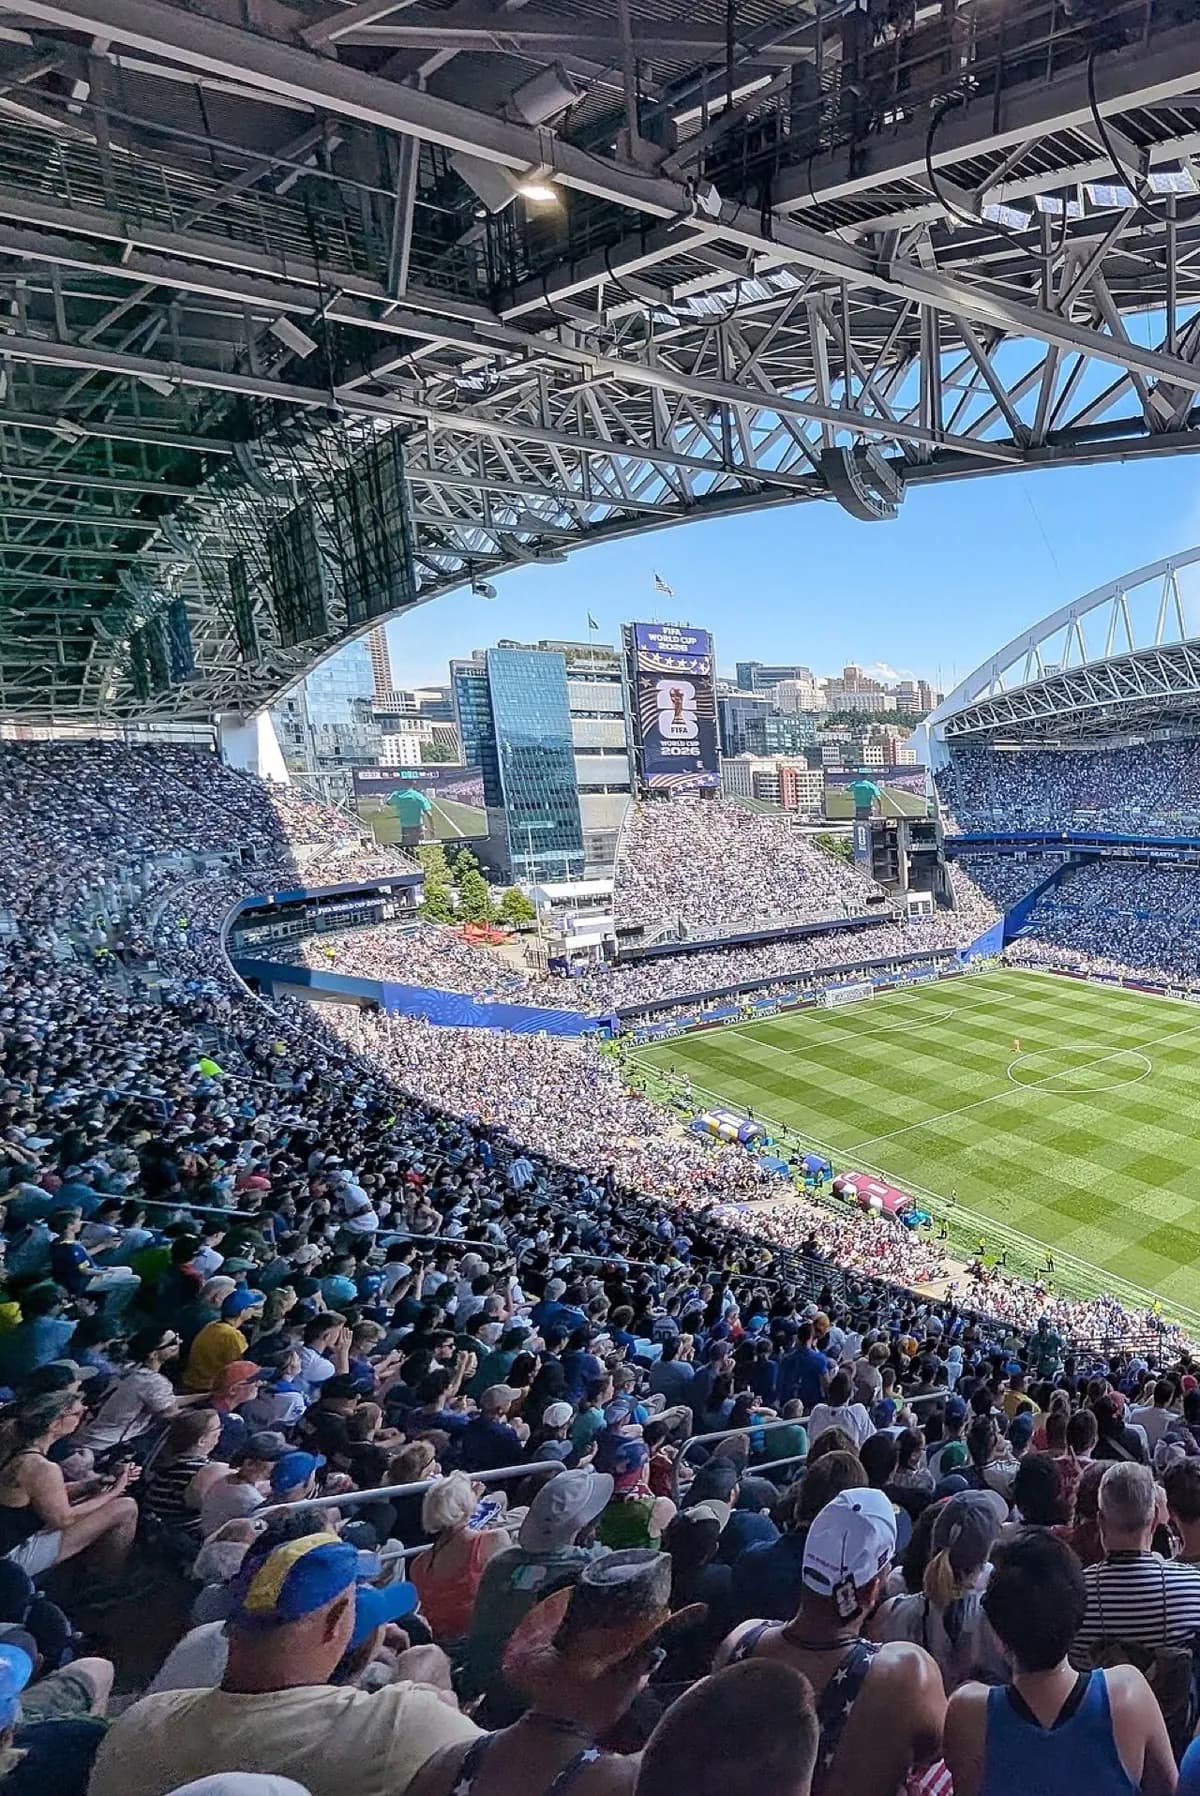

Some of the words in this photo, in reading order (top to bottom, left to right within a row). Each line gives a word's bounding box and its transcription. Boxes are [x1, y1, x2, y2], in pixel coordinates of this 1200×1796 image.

[662, 627, 682, 636] FIFA
[648, 633, 679, 643] WORLD
[680, 636, 697, 645] CUP
[658, 642, 689, 652] 2026
[660, 747, 701, 756] 2026
[723, 1014, 749, 1026] QATAR
[621, 1035, 650, 1048] QATAR
[652, 1027, 687, 1042] AIRWAYS
